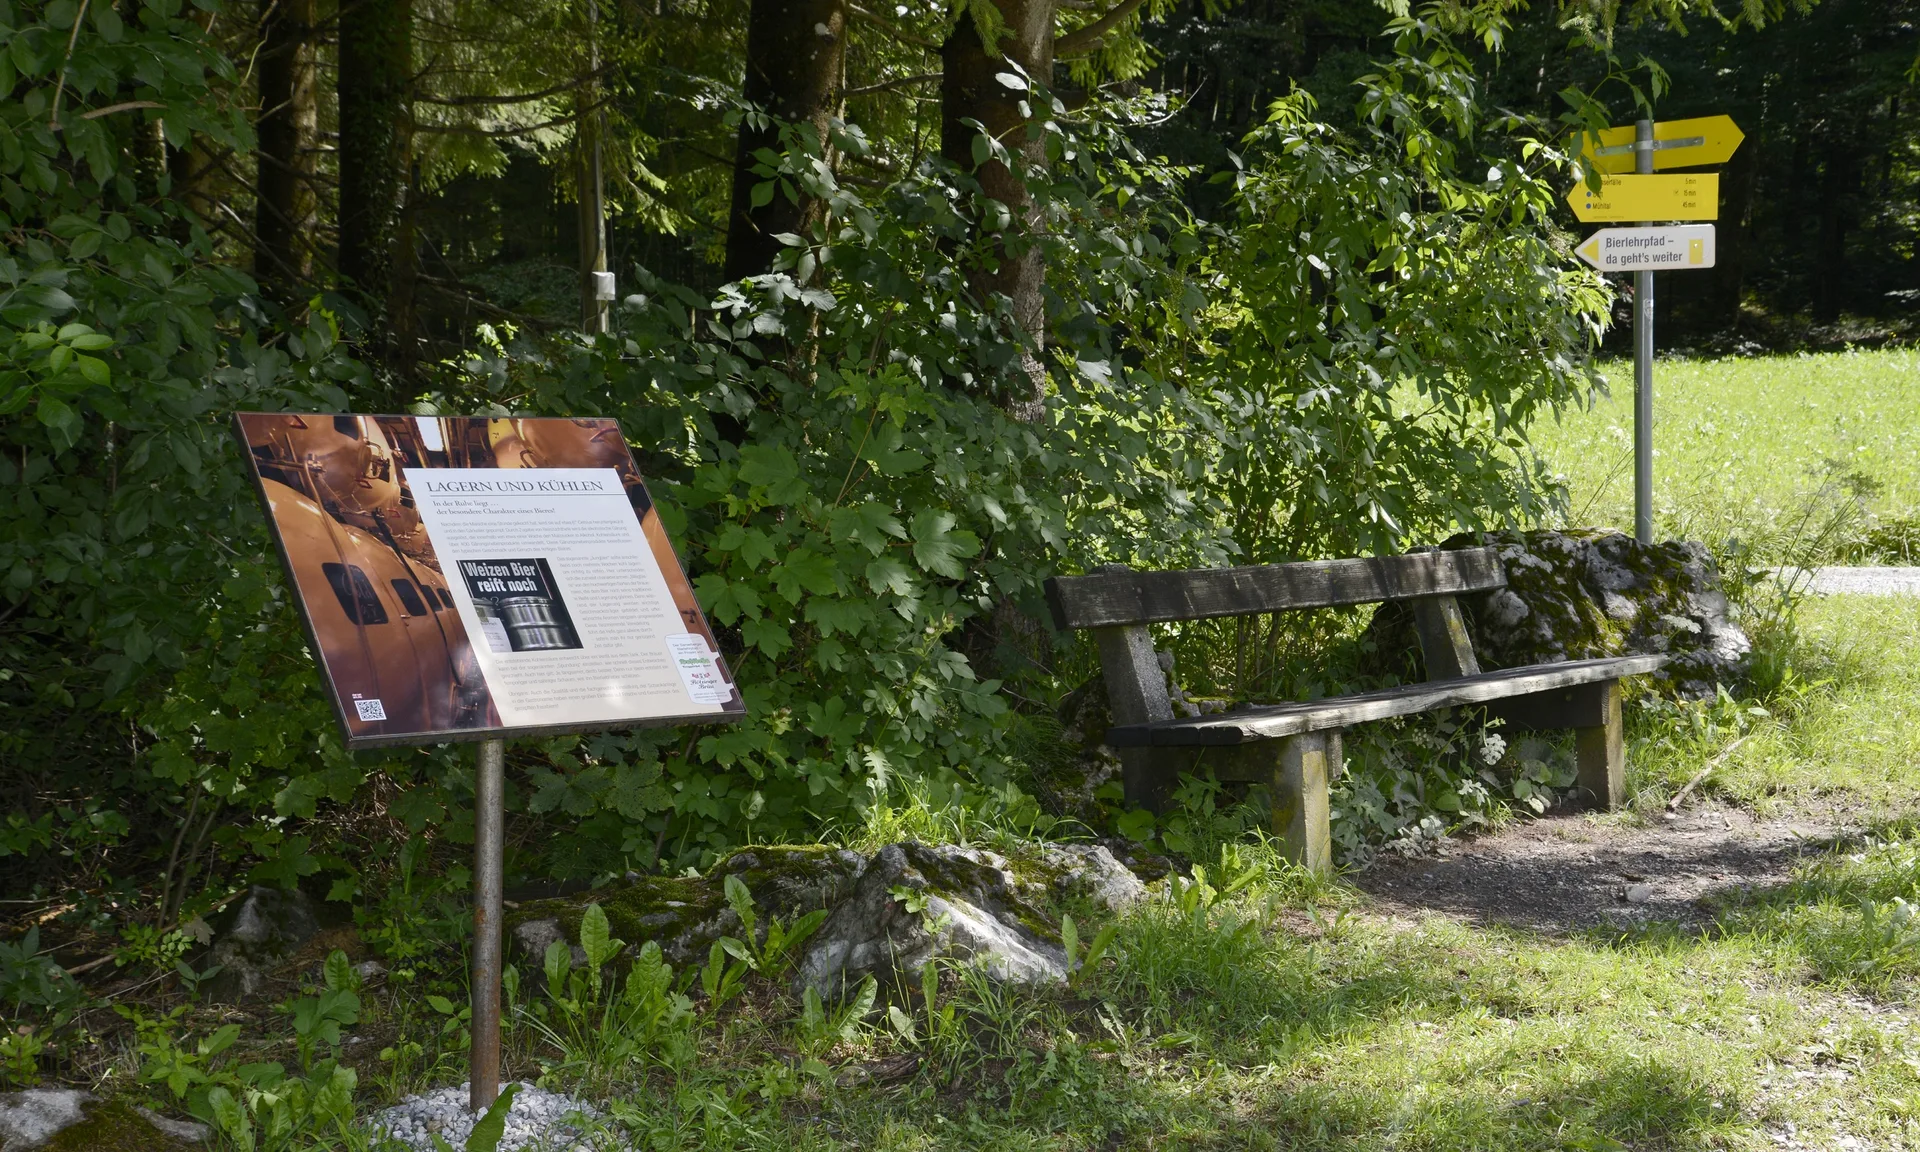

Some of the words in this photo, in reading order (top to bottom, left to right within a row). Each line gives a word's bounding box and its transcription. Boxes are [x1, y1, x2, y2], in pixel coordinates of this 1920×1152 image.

[1606, 236, 1665, 248] Bierlehrpfad
[1606, 254, 1617, 264] da
[1620, 253, 1649, 265] geht's
[1653, 252, 1683, 262] weiter
[426, 481, 493, 492] LAGERN
[496, 481, 534, 492] UND
[537, 480, 604, 491] KÜHLEN
[463, 562, 510, 577] Weizen
[510, 562, 536, 576] Bier
[477, 579, 507, 592] reift
[508, 578, 538, 591] noch
